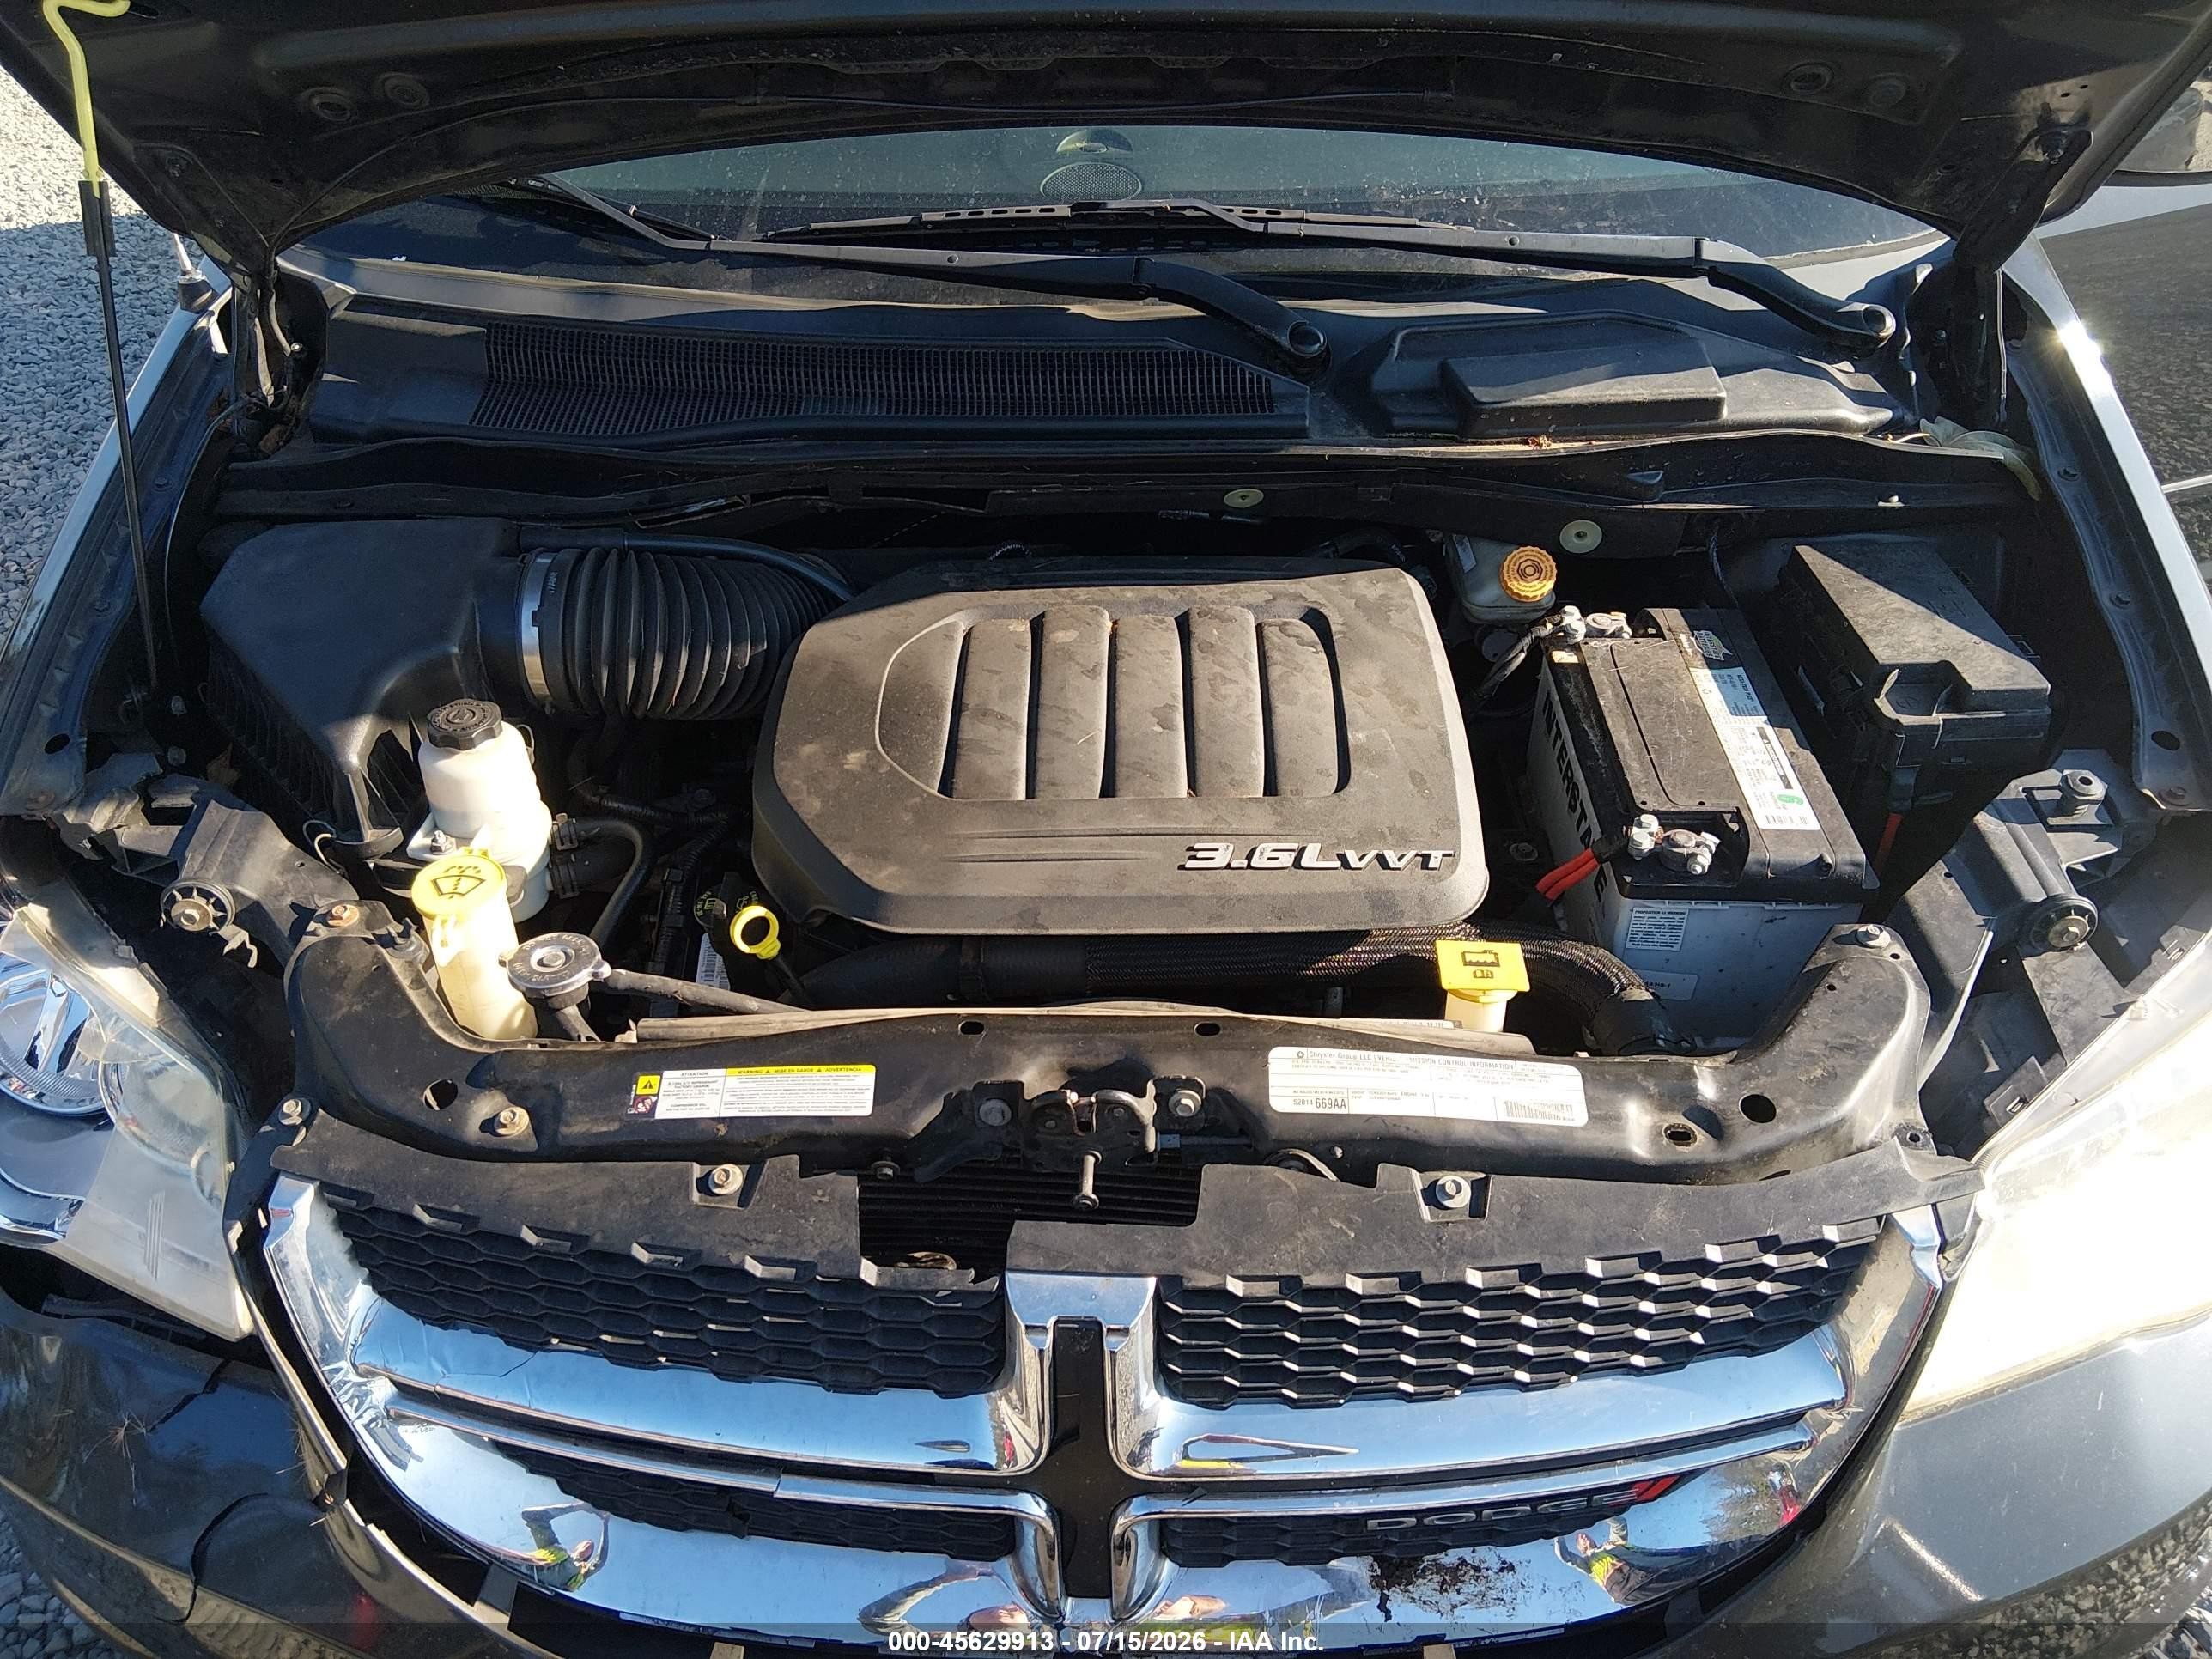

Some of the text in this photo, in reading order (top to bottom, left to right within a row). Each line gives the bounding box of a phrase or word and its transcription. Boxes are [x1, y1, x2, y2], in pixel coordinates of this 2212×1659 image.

[1543, 690, 1608, 902] INTERSTAE
[1178, 842, 1341, 871] 3.6L
[1337, 1052, 1358, 1060] Group
[1406, 1057, 1437, 1066] MISSION
[1437, 1059, 1468, 1067] CONTROL
[1469, 1060, 1515, 1070] INFORMATION
[1315, 1097, 1347, 1109] 669AA
[1367, 1488, 1638, 1531] DODGE
